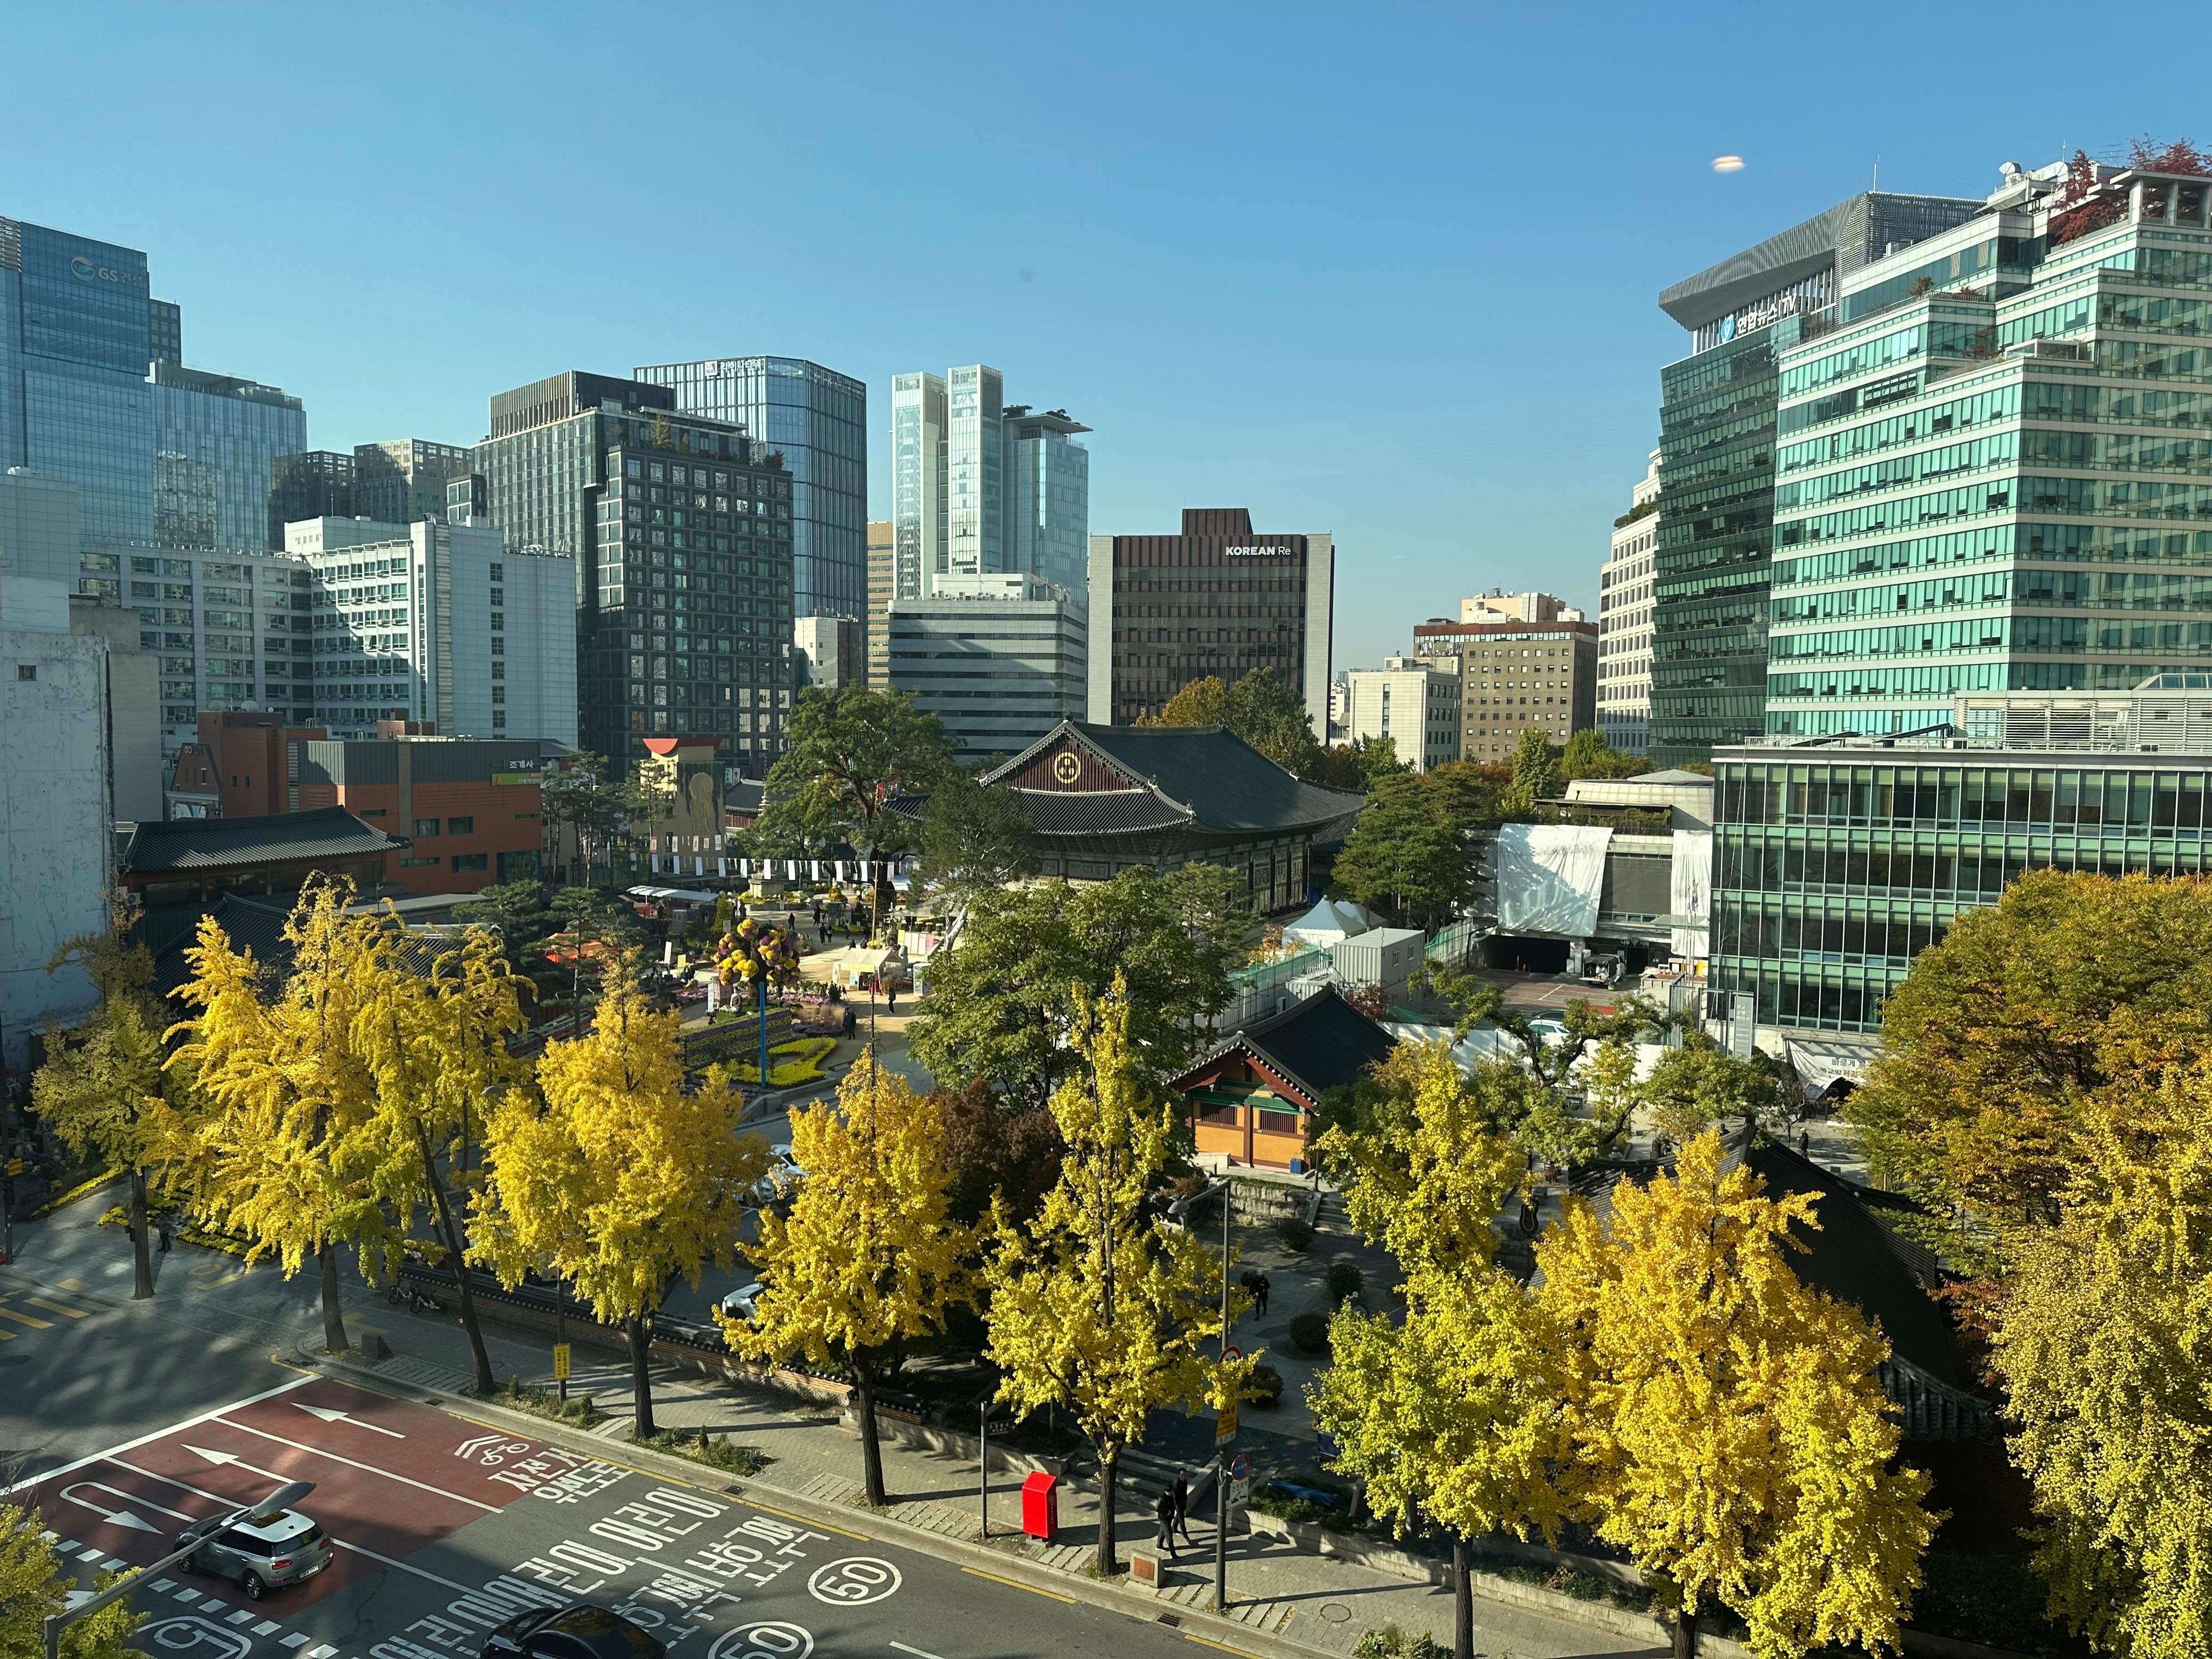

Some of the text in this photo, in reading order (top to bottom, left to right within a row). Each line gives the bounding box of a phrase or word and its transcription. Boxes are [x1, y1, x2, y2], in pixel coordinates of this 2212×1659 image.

[98, 268, 118, 282] GS
[1737, 303, 1778, 335] 연합뉴스
[1226, 546, 1291, 555] KOREAN Re
[1832, 1058, 1855, 1067] 빠르게
[487, 1447, 590, 1492] 자전거
[533, 1460, 634, 1504] 우선도로
[589, 1487, 730, 1551] 어린이
[685, 1515, 831, 1588] 보호구역
[483, 1539, 636, 1609] 어린이
[817, 1563, 888, 1600] 50
[720, 1627, 799, 1659] 50
